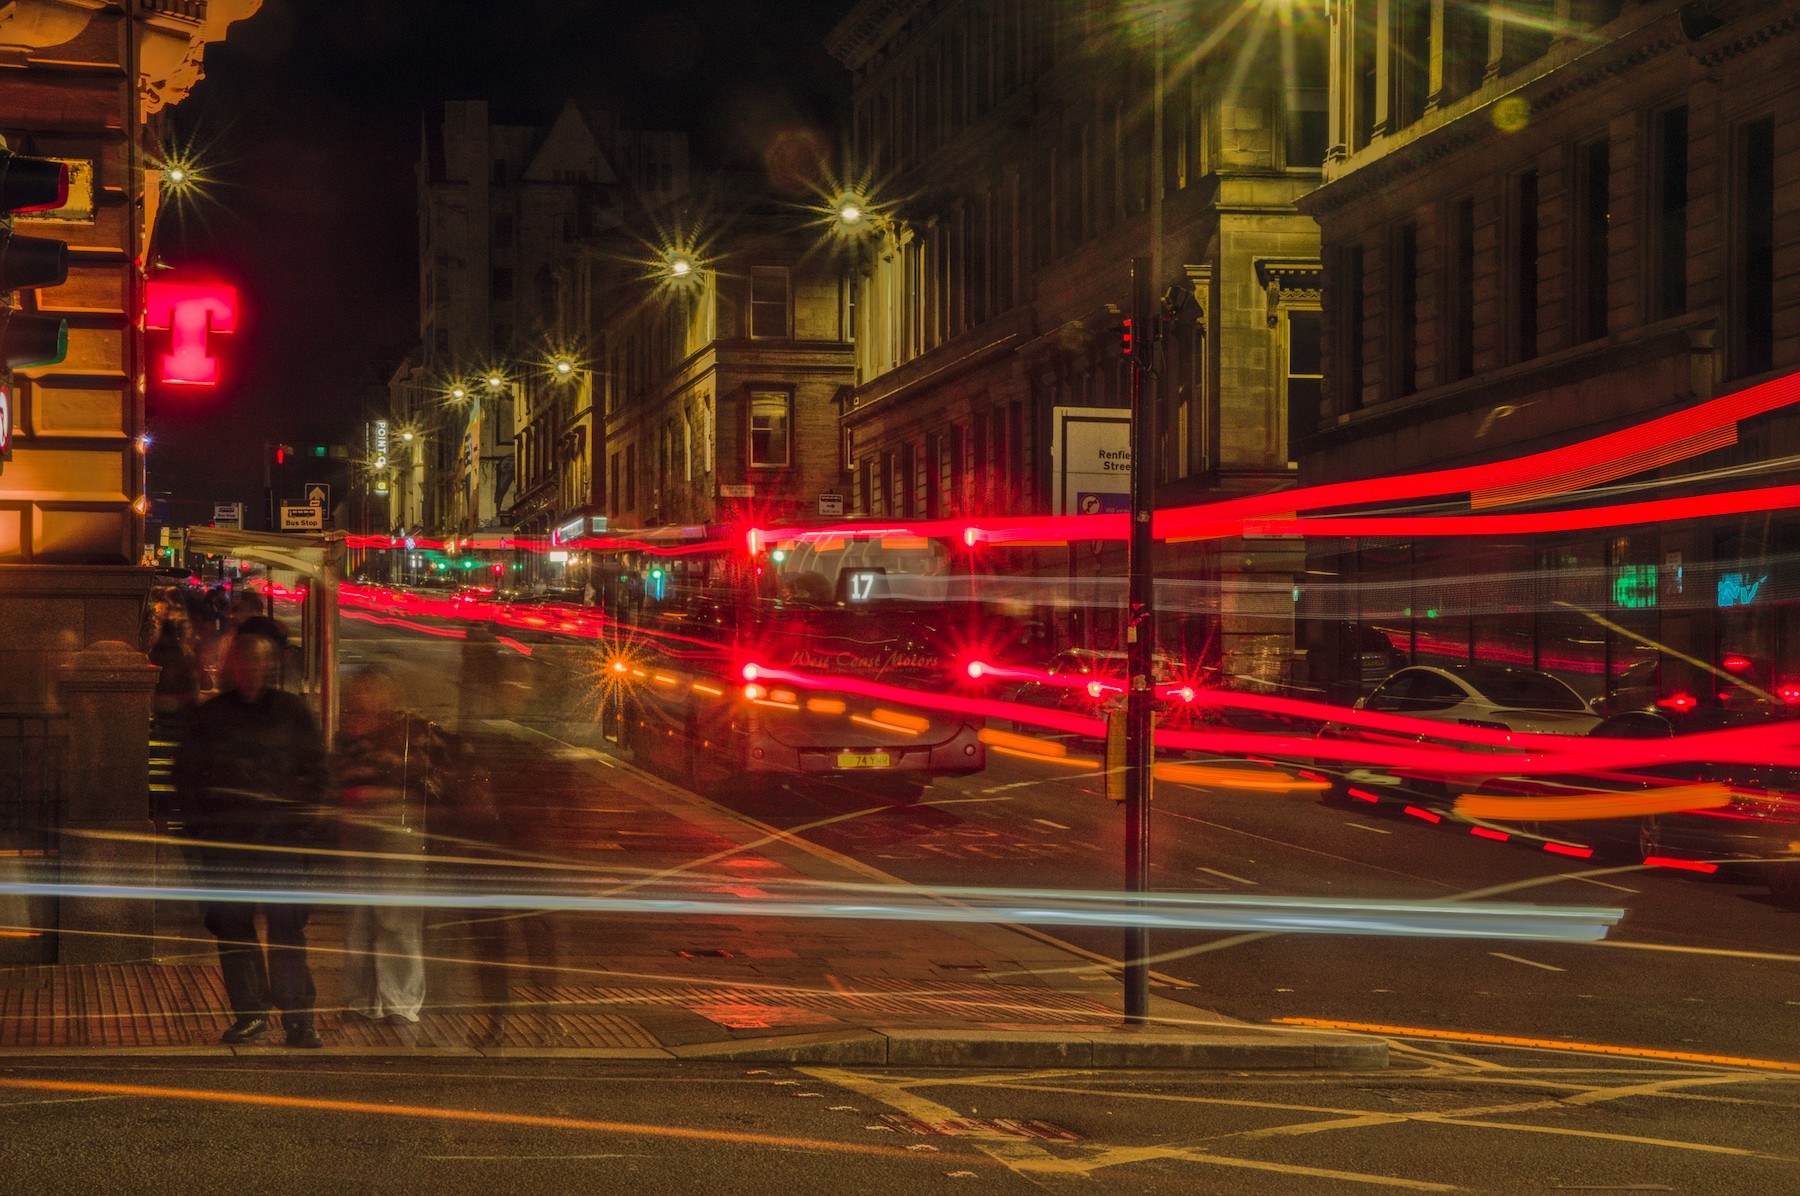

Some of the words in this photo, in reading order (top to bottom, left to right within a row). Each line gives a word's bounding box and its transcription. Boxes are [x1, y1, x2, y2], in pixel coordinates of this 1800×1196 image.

[146, 282, 236, 385] T
[377, 422, 387, 454] POINT
[1099, 449, 1131, 460] Renfie
[1103, 461, 1131, 471] Stree
[300, 519, 318, 527] Stop
[851, 574, 874, 600] 17
[790, 648, 829, 668] West
[874, 649, 939, 681] Motors
